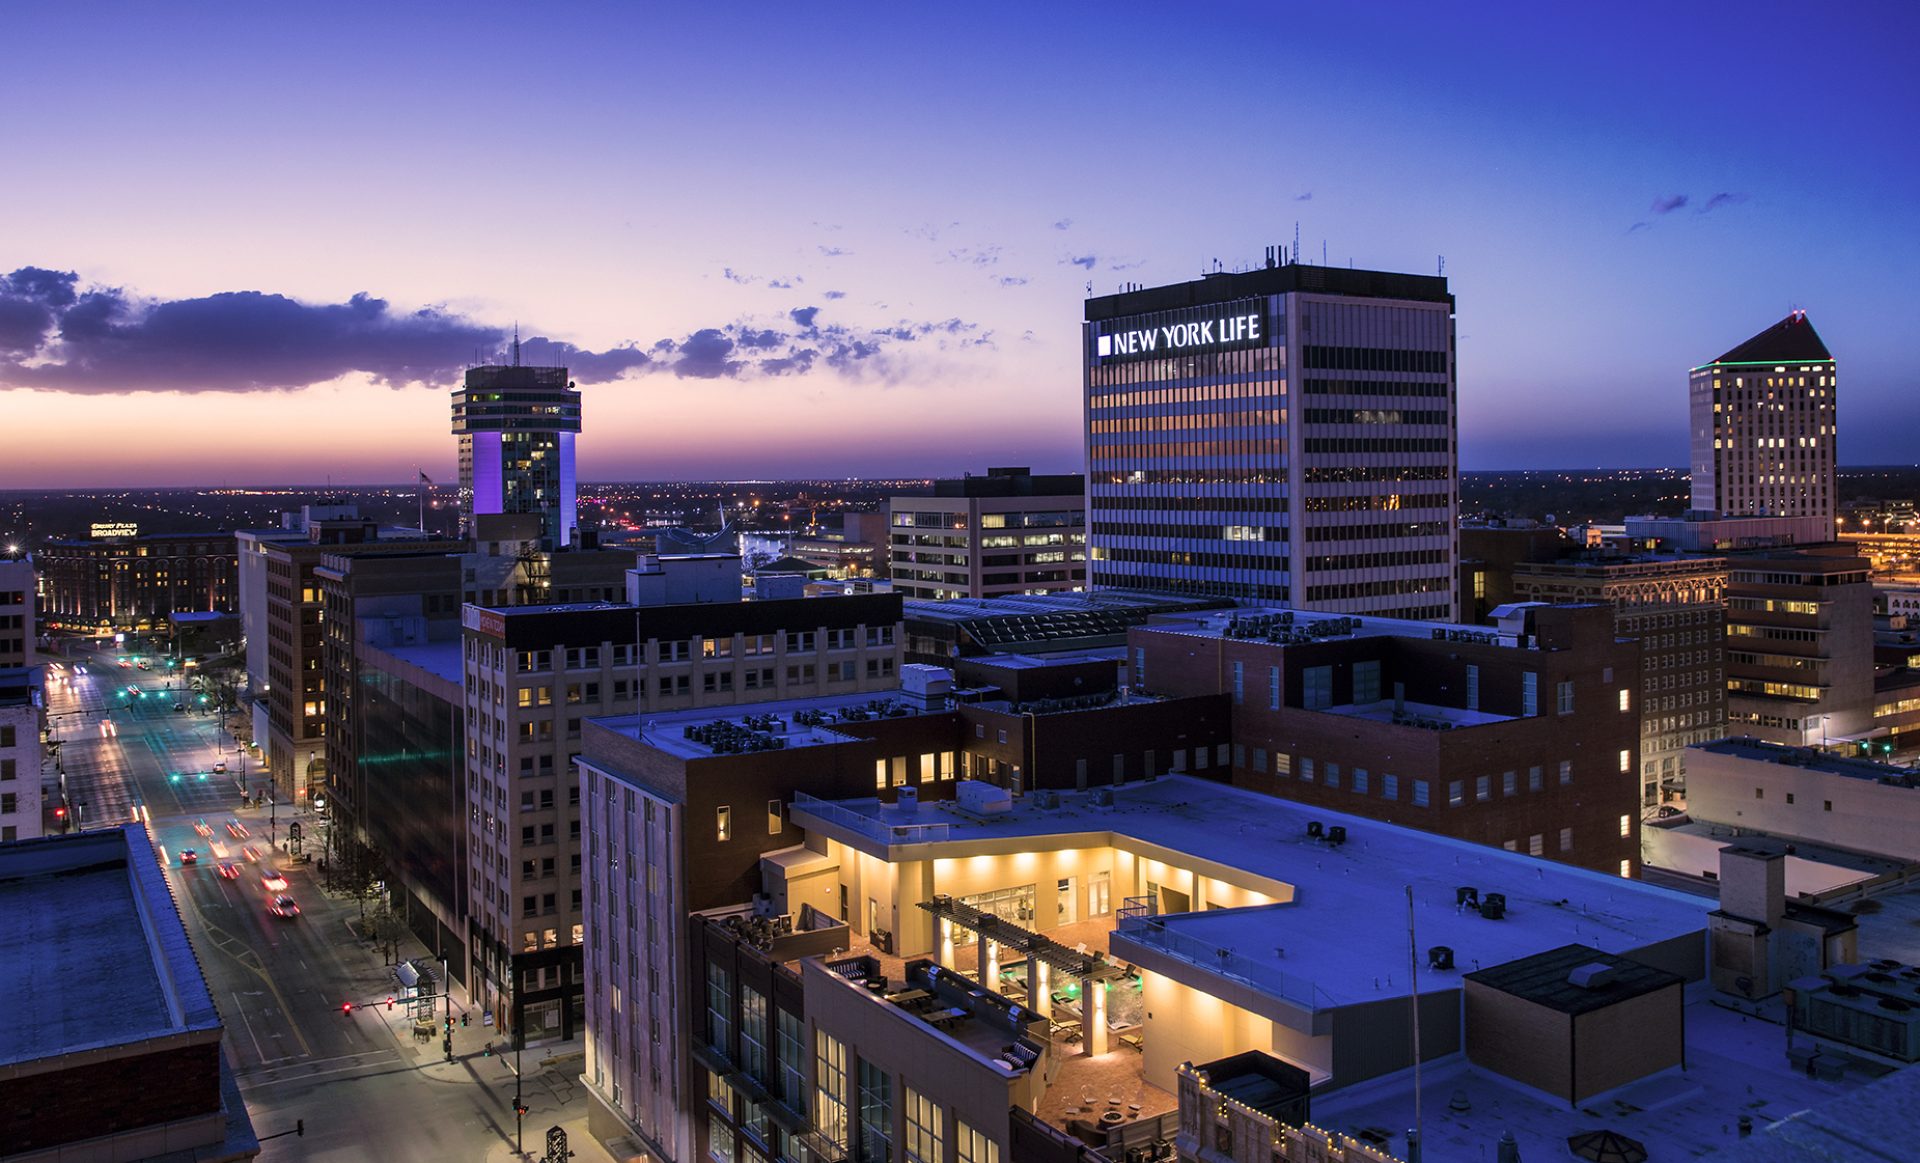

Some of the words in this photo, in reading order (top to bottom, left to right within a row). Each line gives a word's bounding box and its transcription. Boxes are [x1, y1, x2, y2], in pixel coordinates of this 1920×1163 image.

[1114, 328, 1158, 355] NEW
[1161, 320, 1214, 349] YORK
[1219, 314, 1260, 343] LIFE
[91, 529, 137, 537] BROADVIEW
